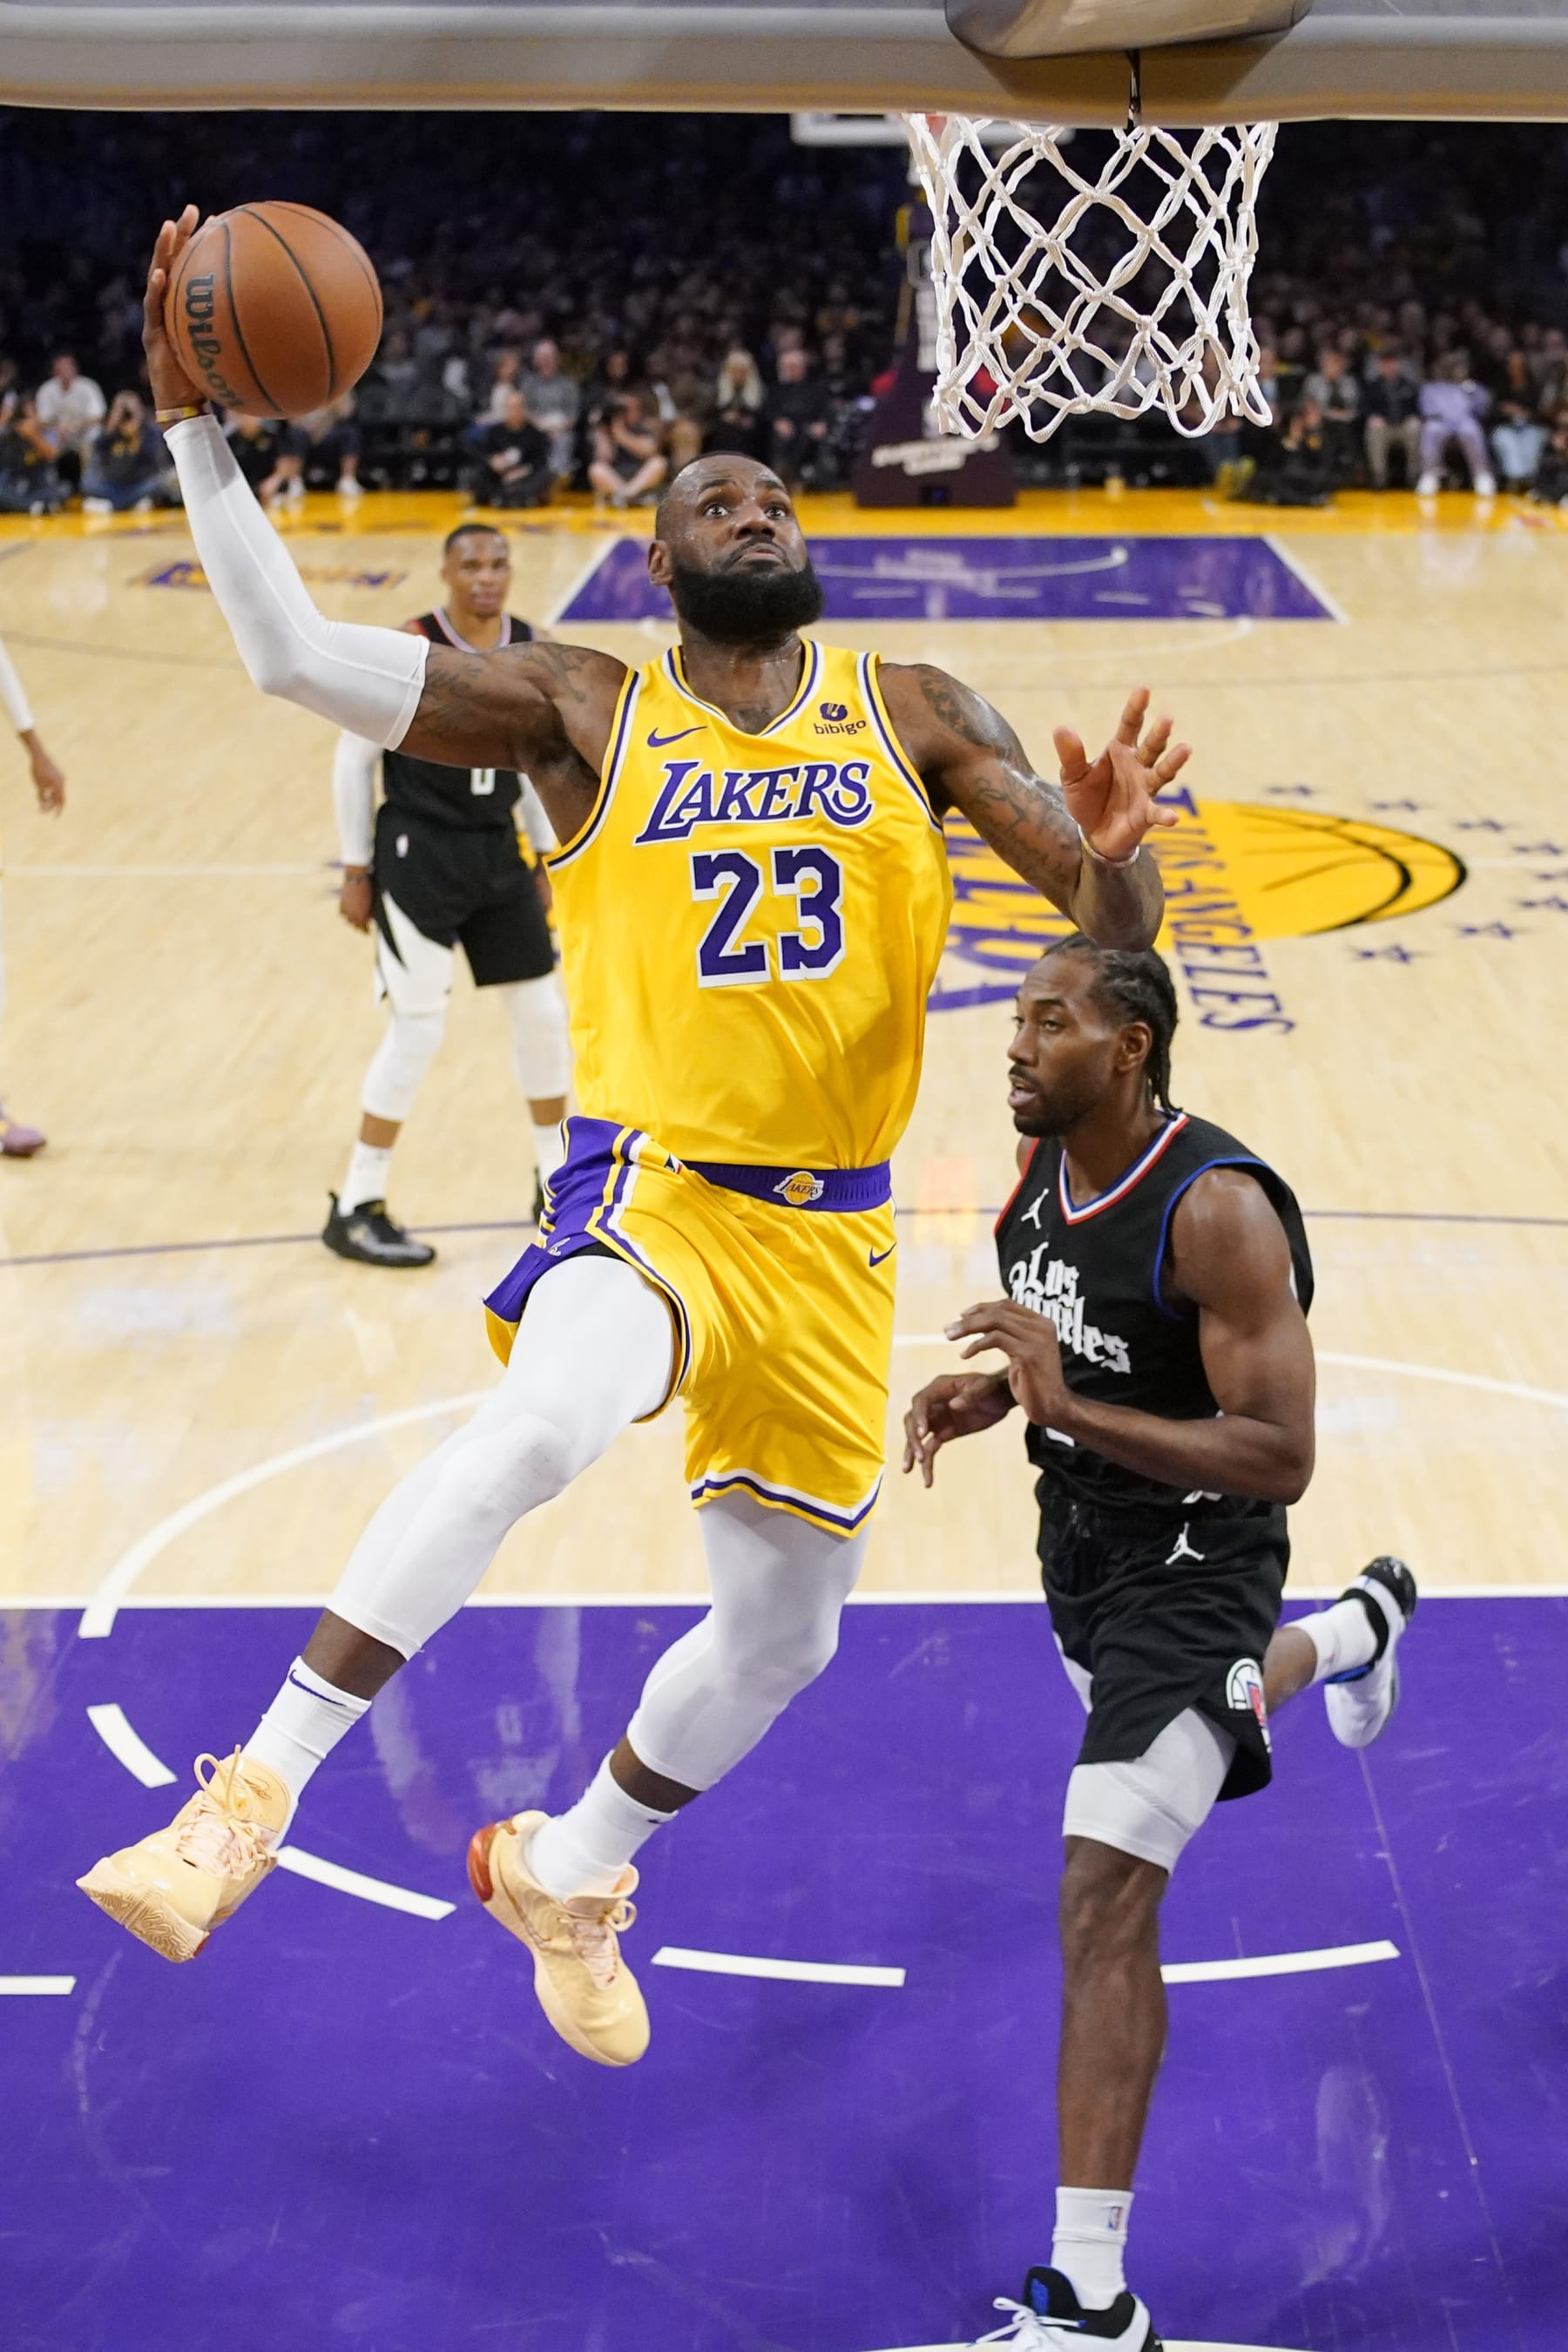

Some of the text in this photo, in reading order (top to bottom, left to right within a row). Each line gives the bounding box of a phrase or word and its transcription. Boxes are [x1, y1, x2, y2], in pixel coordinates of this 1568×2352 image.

[814, 720, 866, 735] bibigo
[634, 760, 874, 845] LAKERS
[690, 845, 845, 987] 23
[1024, 1241, 1079, 1307] Los
